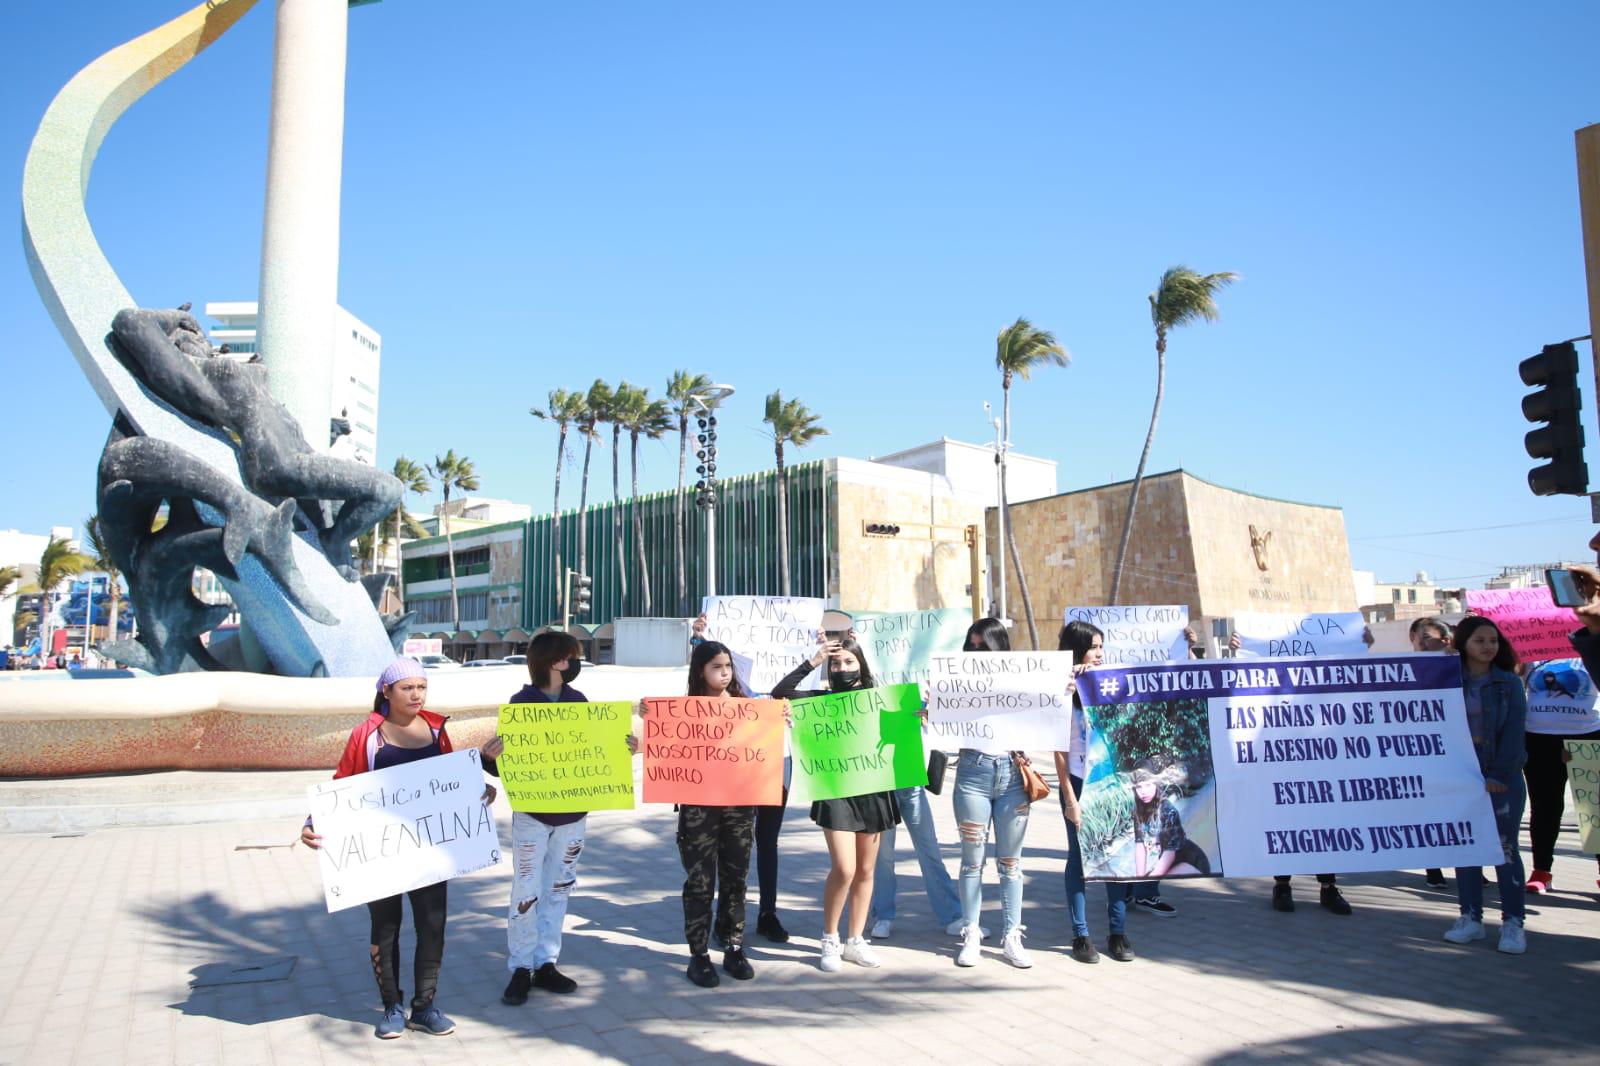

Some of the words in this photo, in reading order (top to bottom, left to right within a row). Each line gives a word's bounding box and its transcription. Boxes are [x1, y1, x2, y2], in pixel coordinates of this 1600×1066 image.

[855, 612, 942, 634] JUSTICIA
[1069, 607, 1121, 624] SOMOS
[1269, 640, 1317, 656] PARA
[932, 657, 958, 675] TE
[962, 657, 1021, 675] CANSAS
[1126, 670, 1214, 697] JUSTICIA
[1221, 668, 1280, 689] PARA
[1287, 663, 1417, 686] VALENTINA
[648, 699, 679, 718] TE
[684, 699, 759, 720] CANSAS
[792, 691, 886, 720] JUSTICIA
[937, 692, 1032, 710] NOSOTROS
[502, 706, 579, 724] SERIAMOS
[1225, 706, 1256, 729] LAS
[1262, 701, 1314, 730] NIÑAS
[1321, 703, 1346, 726] NO
[1353, 702, 1374, 725] SE
[1380, 699, 1446, 724] TOCAN
[501, 733, 538, 747] PERO
[545, 731, 564, 745] NO
[569, 731, 587, 743] SE
[647, 720, 673, 738] DE
[676, 720, 734, 740] OIRLO?
[814, 720, 857, 741] PARA
[501, 752, 547, 767] PUEDE
[553, 746, 605, 763] LUCHAR
[647, 743, 739, 763] NOSOTROS
[745, 747, 765, 762] DE
[1236, 740, 1257, 764] EL
[1263, 737, 1338, 763] ASESINO
[1345, 736, 1371, 759] NO
[1376, 733, 1446, 758] PUEDE
[504, 770, 547, 782] DESDE
[553, 768, 567, 780] EL
[573, 765, 611, 778] CIELO
[800, 753, 888, 775] VALENTINA
[1273, 777, 1334, 805] ESTAR
[1338, 775, 1425, 802] LIBRE!!!
[323, 803, 491, 871] VALENTINA
[1264, 827, 1364, 854] EXIGIMOS
[1368, 821, 1475, 854] JUSTICIA!!
